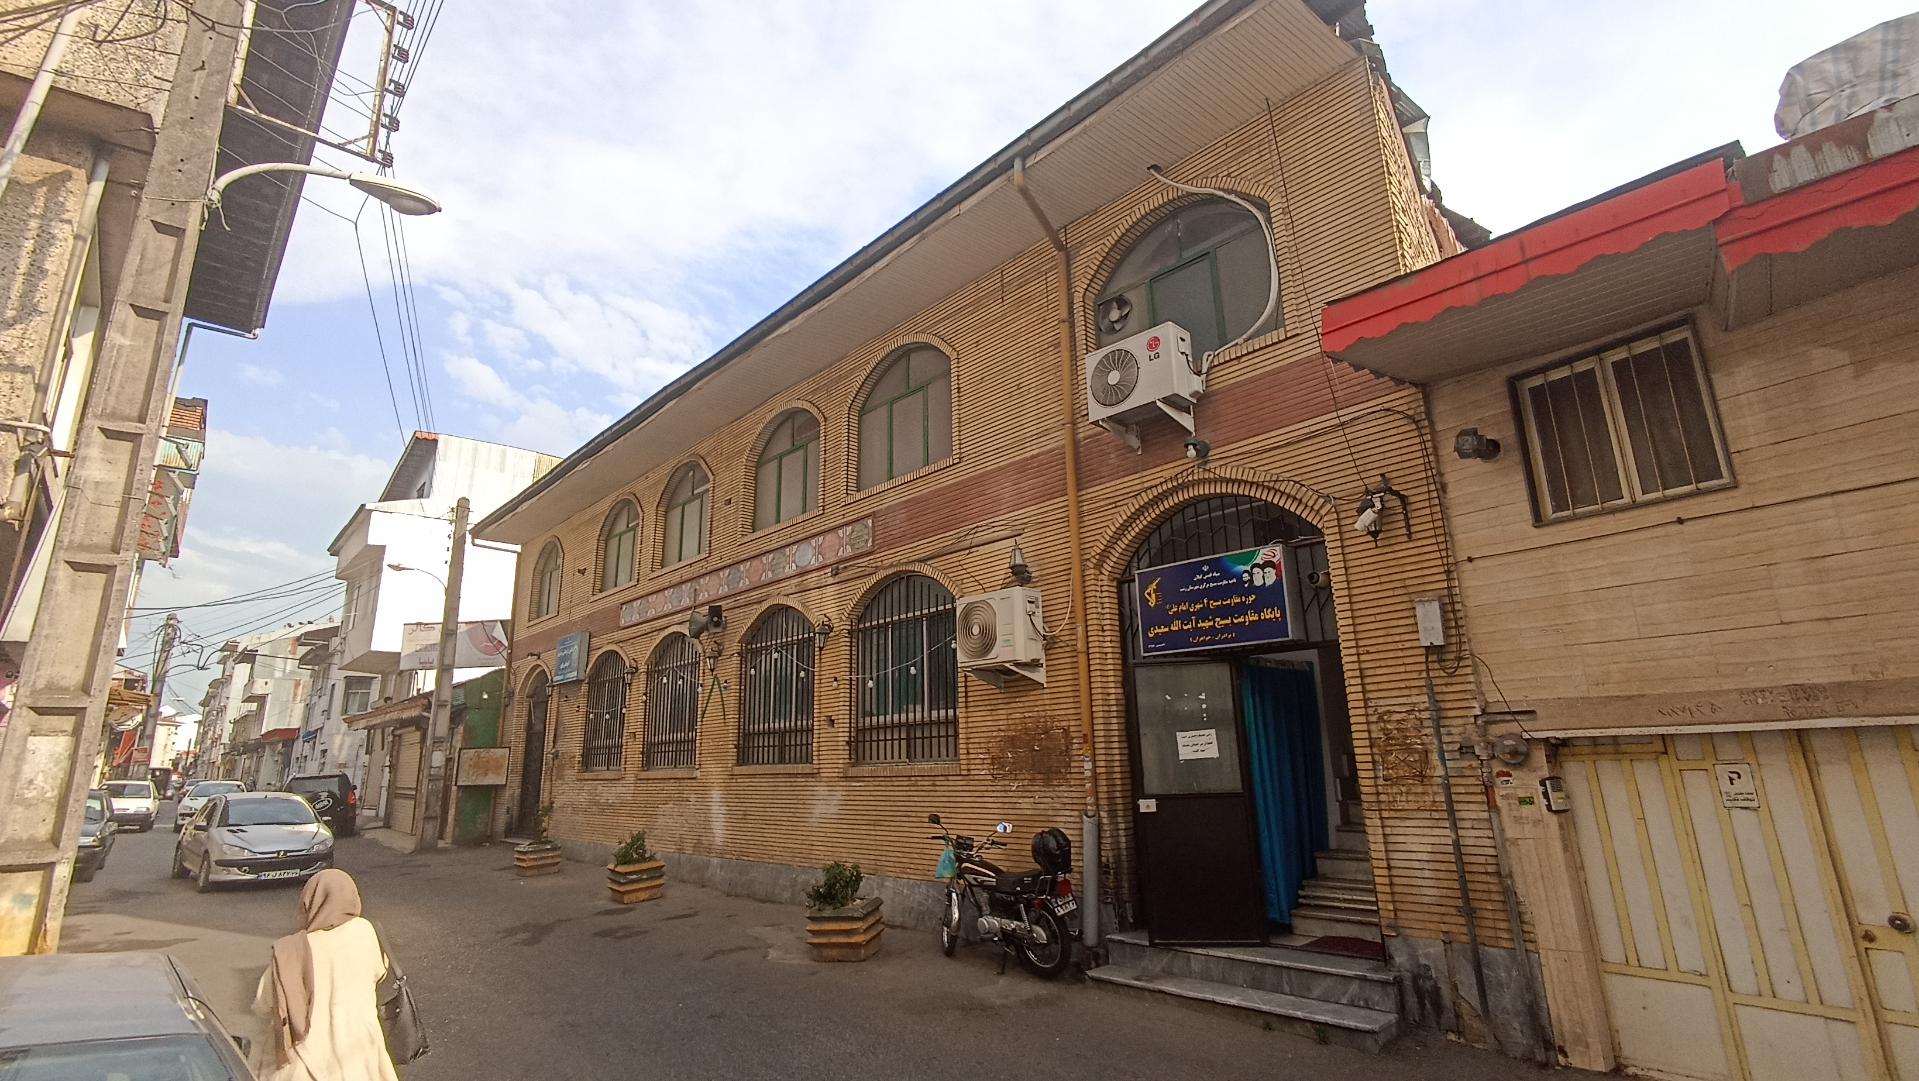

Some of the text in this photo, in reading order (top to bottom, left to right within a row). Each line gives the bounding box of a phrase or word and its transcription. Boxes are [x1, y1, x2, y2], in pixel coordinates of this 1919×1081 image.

[1148, 351, 1160, 362] LG
[1209, 599, 1222, 609] بسیج
[1222, 594, 1241, 607] مقاومت
[1241, 594, 1256, 604] حوزه
[1147, 606, 1282, 638] پایگاه مقاومت بسیج شهید آیت الله سعیدی
